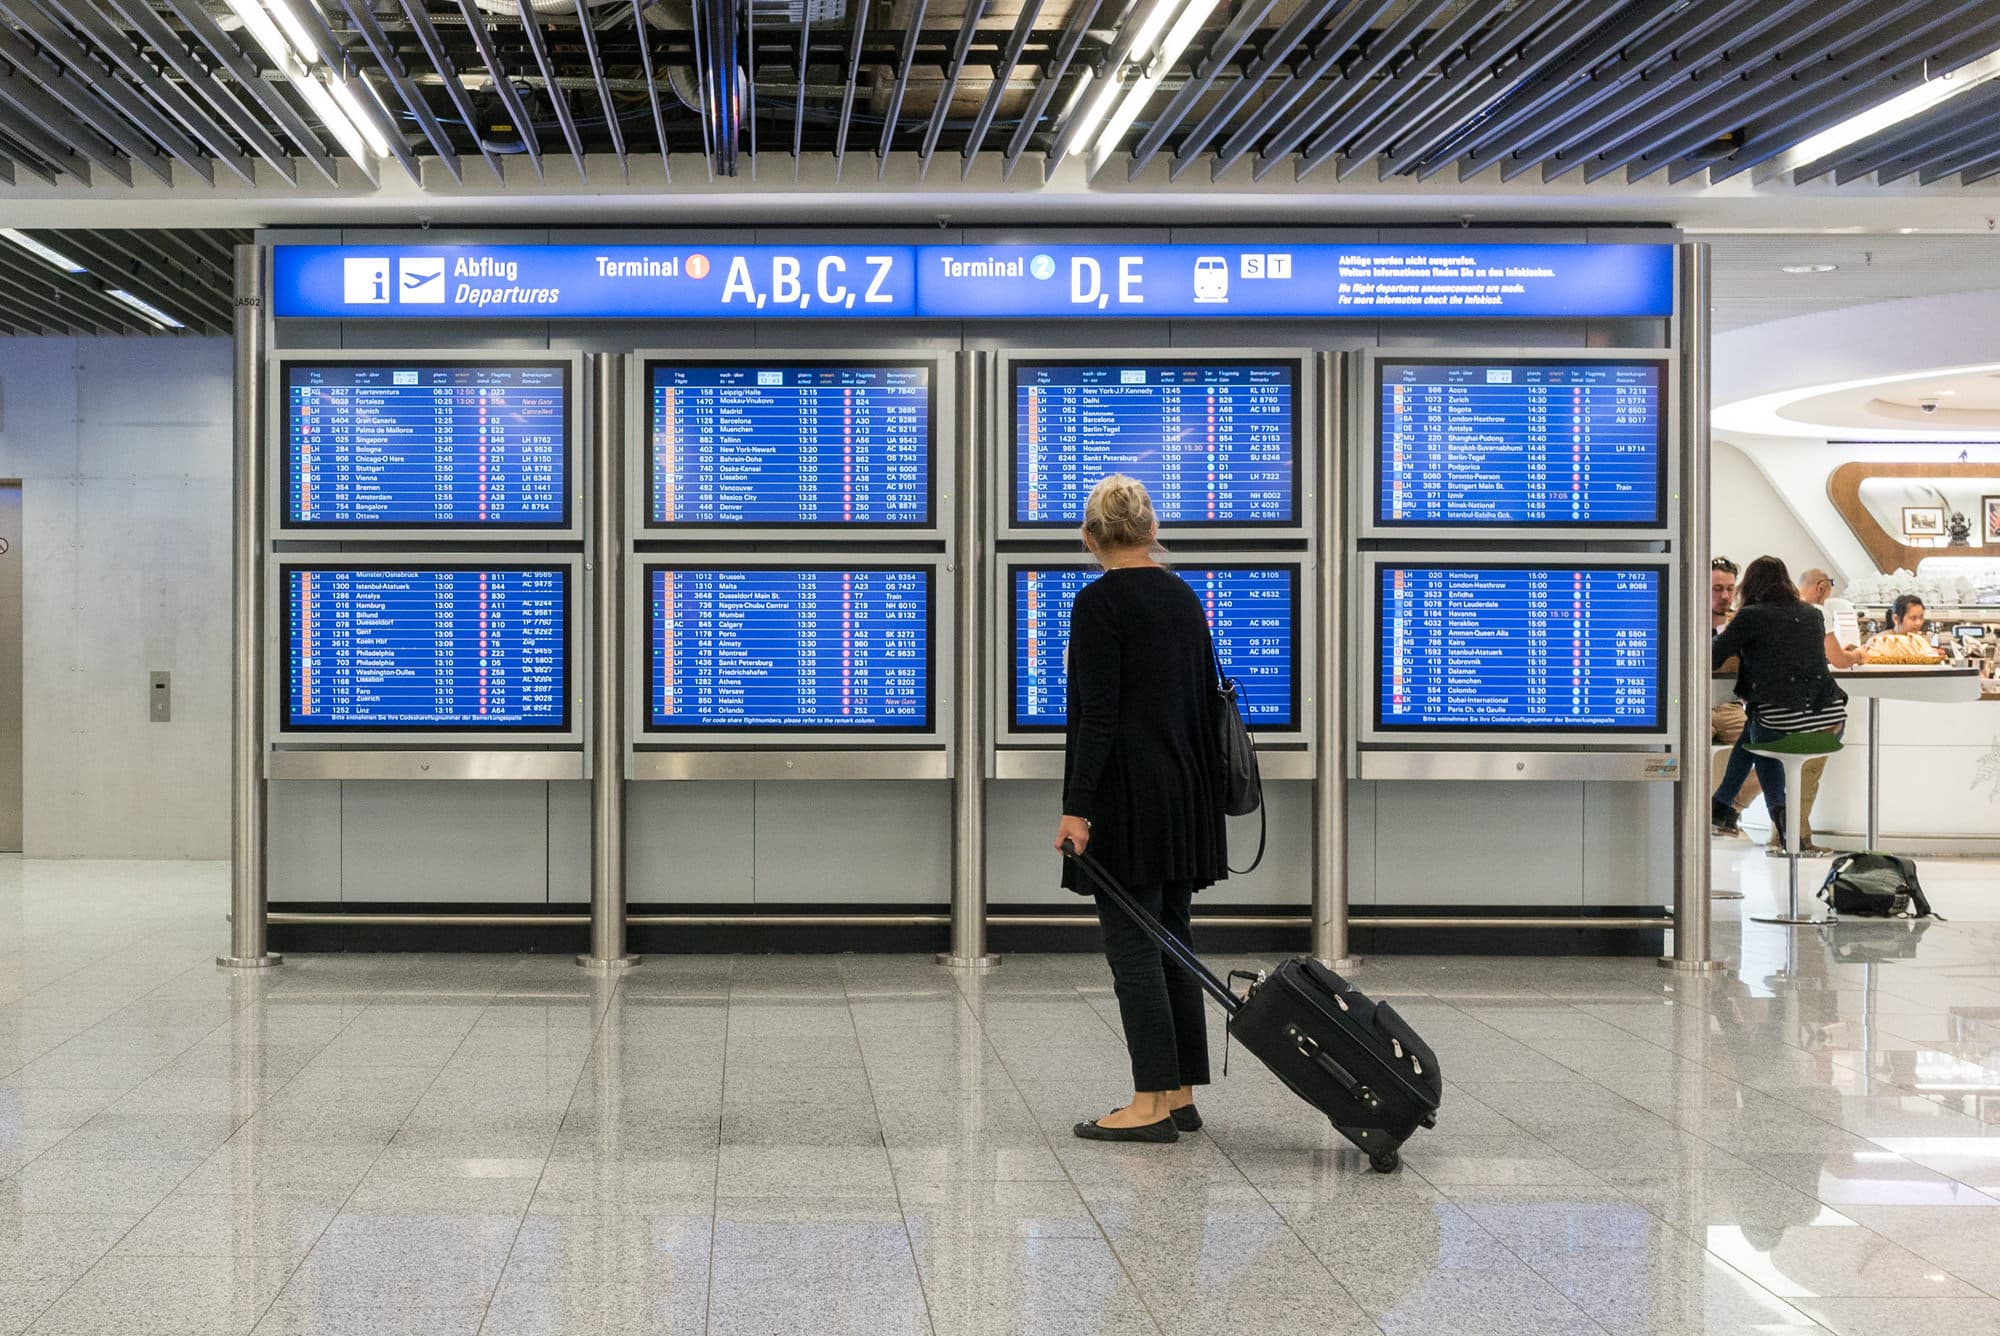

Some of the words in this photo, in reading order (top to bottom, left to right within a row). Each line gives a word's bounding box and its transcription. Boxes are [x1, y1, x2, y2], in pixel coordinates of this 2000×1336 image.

[454, 256, 518, 281] Abflug
[596, 256, 679, 277] Terminal
[941, 256, 1024, 277] Terminal
[1247, 258, 1259, 275] S
[1272, 258, 1286, 275] T
[1339, 256, 1371, 266] Abflüge
[1373, 257, 1404, 265] werden
[1405, 257, 1427, 265] nicht
[1428, 256, 1476, 266] ausgerufen.
[1339, 268, 1371, 277] Weitere
[1373, 267, 1430, 277] Informationen
[1432, 267, 1459, 277] finden
[1460, 268, 1474, 277] Sie
[1488, 268, 1504, 277] den
[454, 283, 560, 307] Departures
[1338, 283, 1351, 293] No
[1352, 283, 1375, 294] flight
[1376, 284, 1420, 294] departures
[1421, 285, 1485, 293] announcements
[1486, 285, 1500, 293] are
[1501, 284, 1525, 293] made.
[1339, 295, 1353, 304] For
[1376, 295, 1422, 304] information
[1423, 295, 1447, 304] check
[1449, 295, 1463, 304] the
